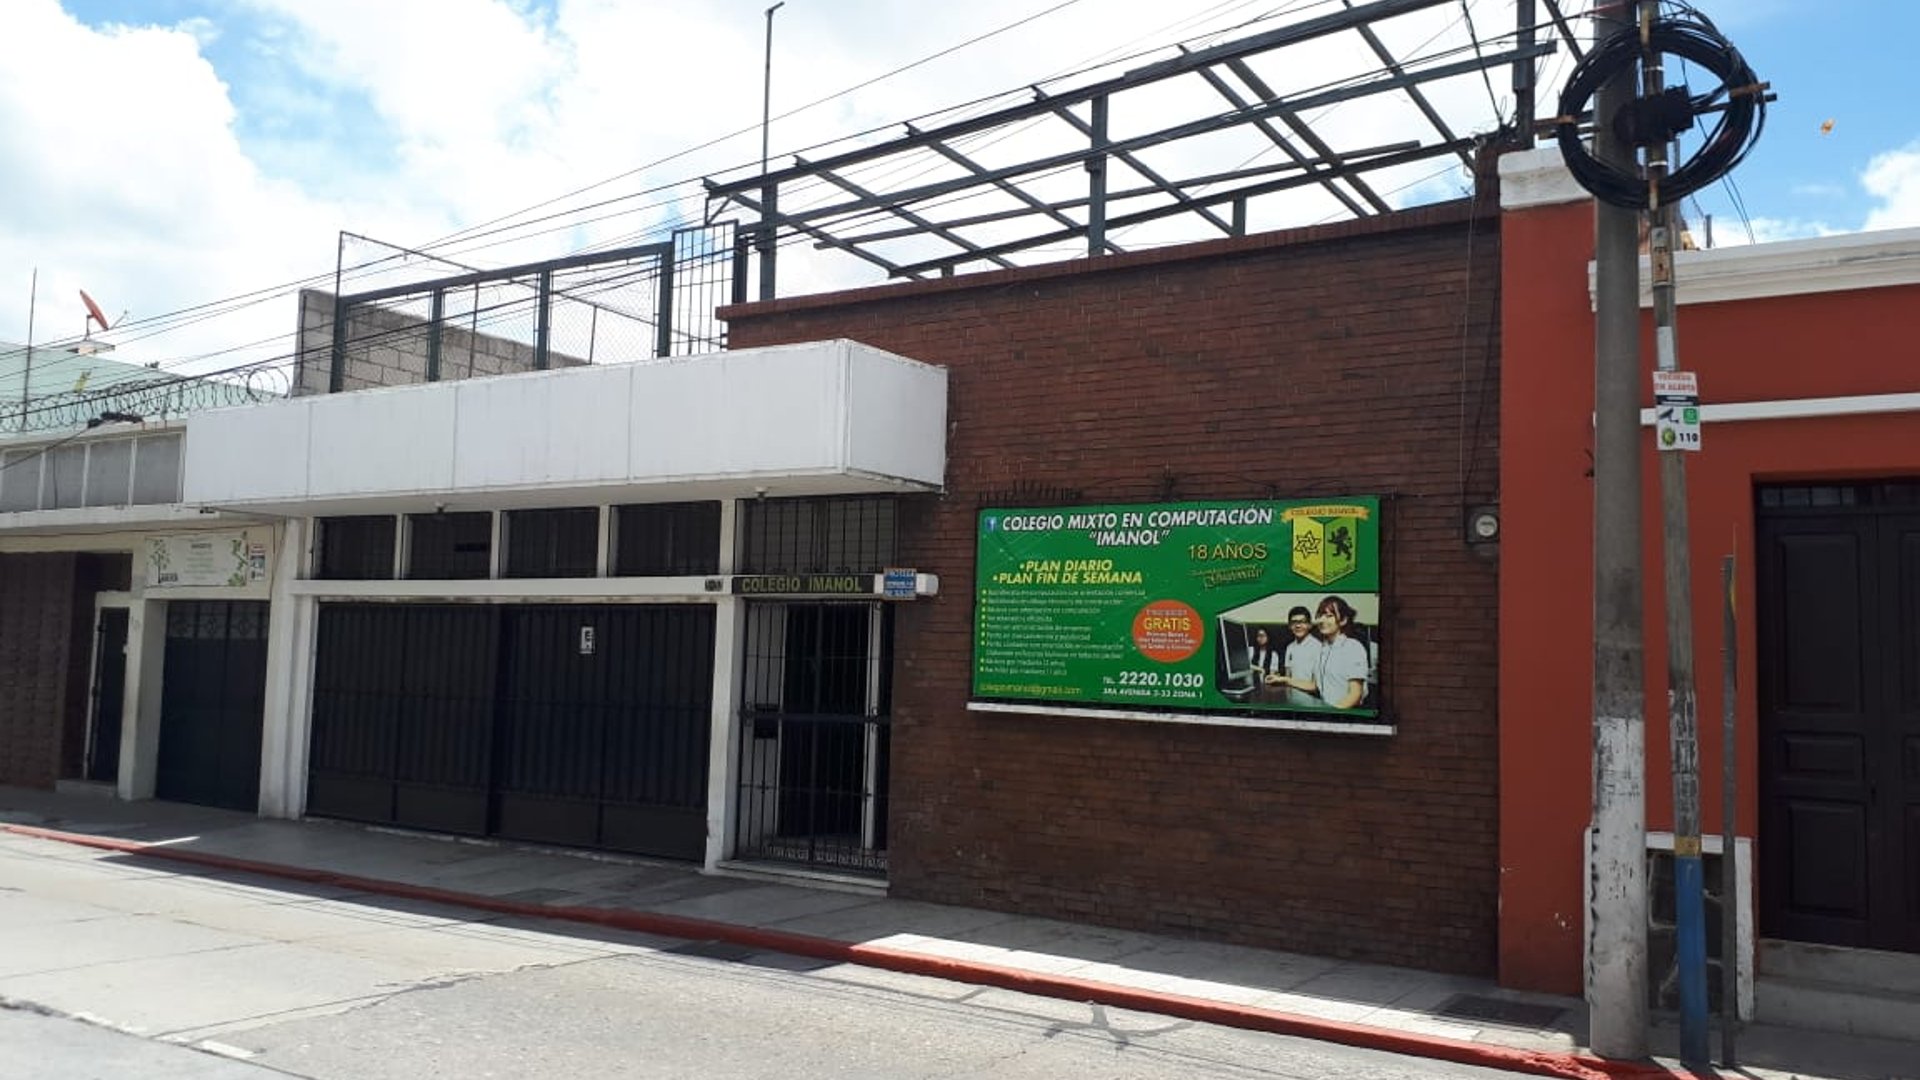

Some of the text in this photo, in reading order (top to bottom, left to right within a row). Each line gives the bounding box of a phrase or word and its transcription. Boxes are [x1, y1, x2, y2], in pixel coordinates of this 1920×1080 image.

[1680, 433, 1699, 443] 110
[1002, 505, 1273, 531] COLEGIO MIXTO EN COMPUTACIÓN
[1188, 541, 1268, 560] 18 AÑOS
[1064, 559, 1113, 572] DIARIO
[741, 577, 801, 593] COLEGIO
[809, 576, 863, 593] IMANOL
[1036, 571, 1060, 584] FIN
[1062, 571, 1080, 584] DE
[1083, 571, 1143, 584] SEMANA
[1144, 616, 1192, 632] GRATIS
[1119, 670, 1204, 688] 2220.1030
[1119, 687, 1151, 697] AVENIDA
